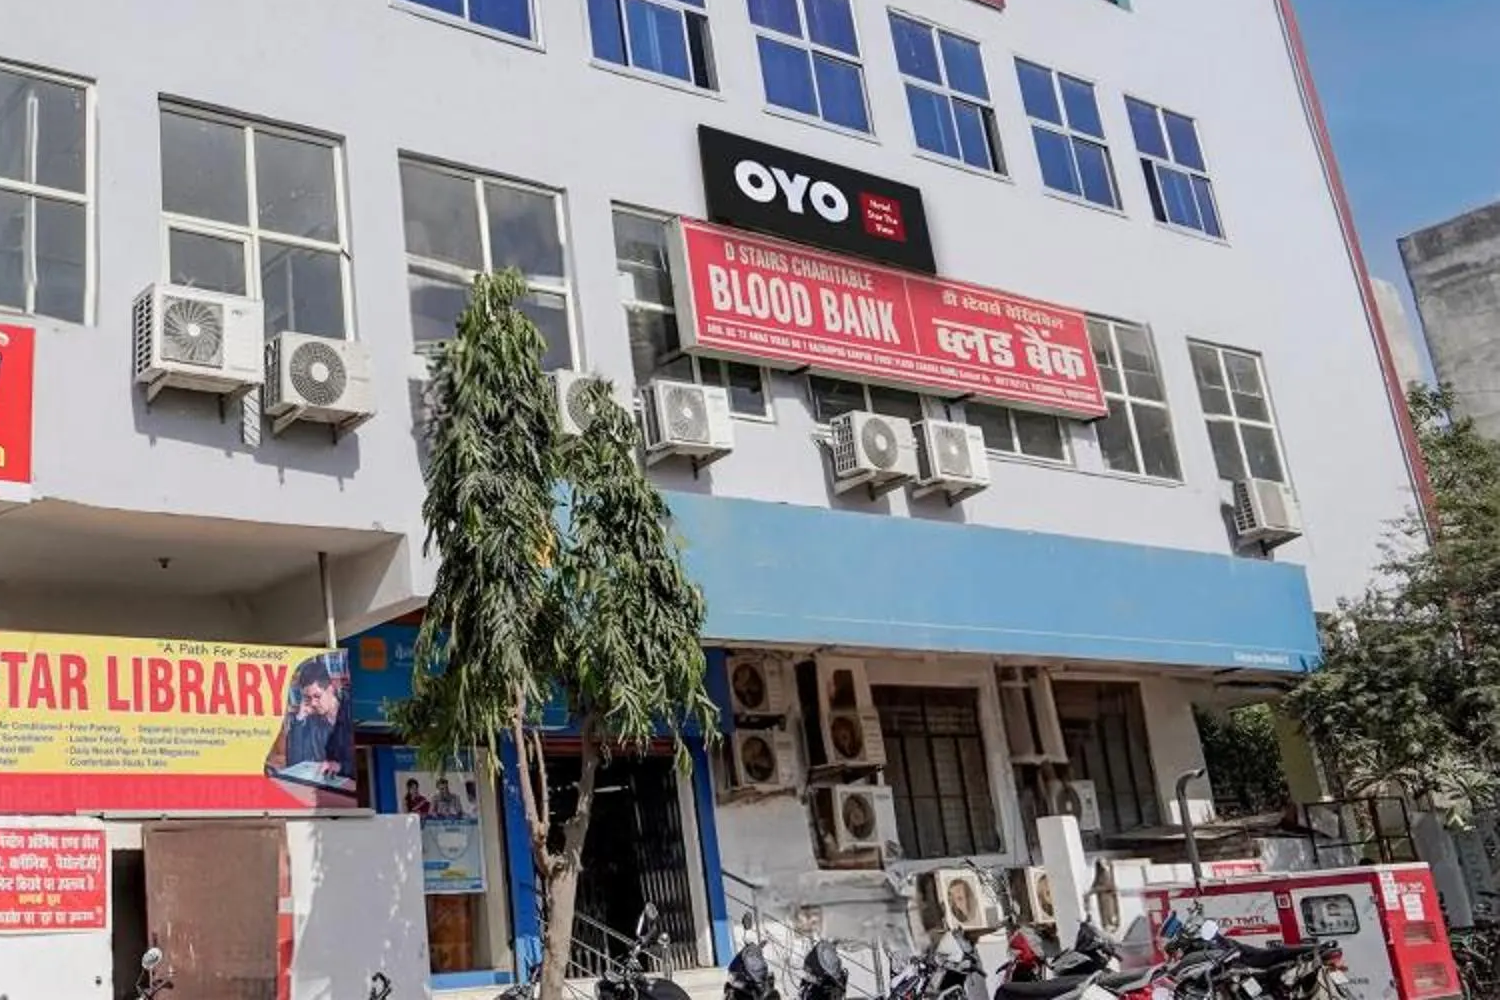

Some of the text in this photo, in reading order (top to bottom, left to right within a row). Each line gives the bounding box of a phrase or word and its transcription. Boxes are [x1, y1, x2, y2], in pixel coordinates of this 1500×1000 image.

[733, 159, 849, 224] OYO
[724, 242, 735, 261] D
[791, 256, 875, 292] CHARITABLE
[708, 263, 901, 345] BLOOD BANK
[931, 317, 1016, 368] ब्लड
[1013, 323, 1087, 381] बैंक
[180, 643, 209, 656] Path
[214, 645, 234, 657] For
[107, 655, 289, 717] LIBRARY
